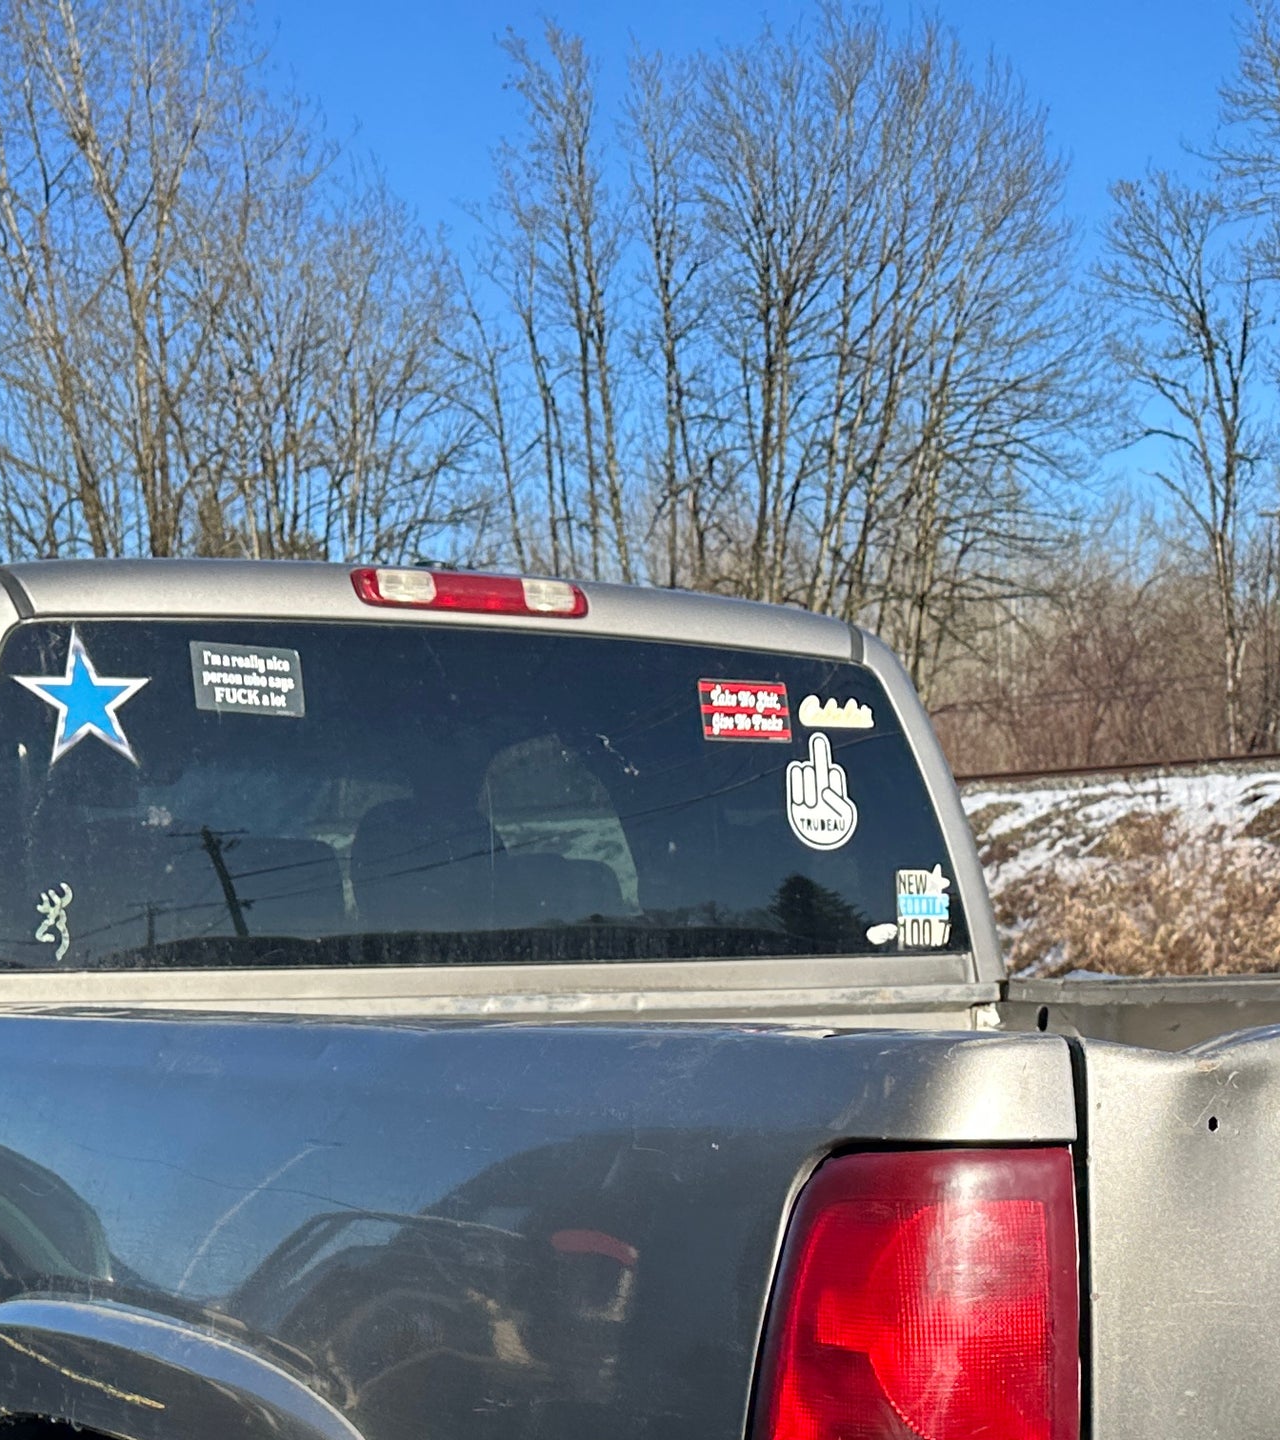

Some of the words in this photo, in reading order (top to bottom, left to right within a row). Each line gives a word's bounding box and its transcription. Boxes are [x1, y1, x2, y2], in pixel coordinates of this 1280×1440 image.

[202, 650, 221, 666] I'm
[222, 654, 230, 667] a
[231, 654, 266, 674] really
[266, 655, 290, 672] nice
[202, 670, 242, 686] person
[243, 672, 268, 687] who
[268, 676, 295, 693] says
[214, 687, 260, 705] FUCK
[261, 694, 269, 706] a
[270, 692, 287, 707] lot
[710, 684, 737, 707] Take
[738, 691, 755, 708] No
[712, 712, 734, 735] Give
[734, 713, 751, 731] No
[799, 818, 845, 831] TRUDEAU
[899, 874, 927, 895] NEW
